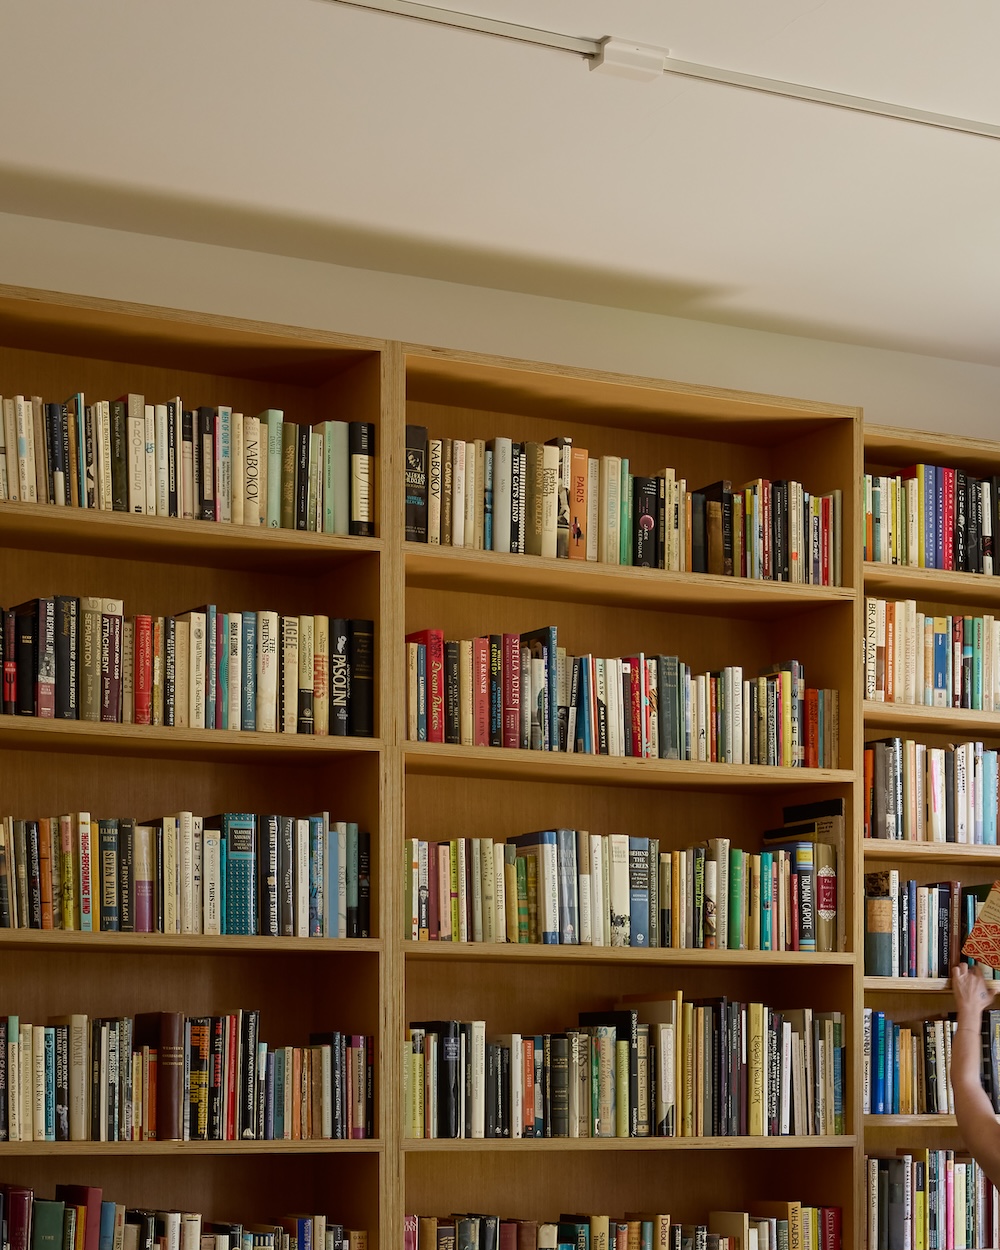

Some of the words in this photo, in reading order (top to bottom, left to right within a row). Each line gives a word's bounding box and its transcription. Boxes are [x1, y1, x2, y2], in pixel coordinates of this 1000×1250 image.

[222, 411, 232, 423] MEN
[222, 424, 233, 432] OF
[222, 433, 233, 445] OUR
[222, 446, 233, 458] TIME
[132, 420, 142, 491] PROFILES
[430, 442, 440, 499] NABOKOV
[535, 449, 543, 488] ANTHONY
[246, 440, 258, 504] NABOKOV
[444, 462, 452, 495] CAVAFY
[549, 468, 557, 494] Evelyn
[576, 476, 585, 503] PARIS
[535, 494, 543, 535] TROLLOPE
[285, 620, 297, 649] AGEE
[868, 603, 876, 638] BRAIN
[246, 644, 254, 680] Passionate
[511, 638, 519, 671] STELLA
[867, 645, 876, 694] MATTERS
[332, 654, 347, 706] PASOLINI
[431, 660, 441, 695] Dream
[511, 675, 519, 705] ADLER
[245, 681, 254, 712] Sightseer
[431, 696, 442, 730] Palaces
[105, 852, 114, 877] SEVEN
[106, 881, 115, 906] PLAYS
[801, 875, 812, 903] TRUMAN
[82, 898, 90, 914] MIND
[802, 903, 813, 929] CAPOTE
[73, 1026, 83, 1066] DINOSAUR
[190, 1070, 199, 1103] THEATER
[660, 1218, 668, 1247] Detour
